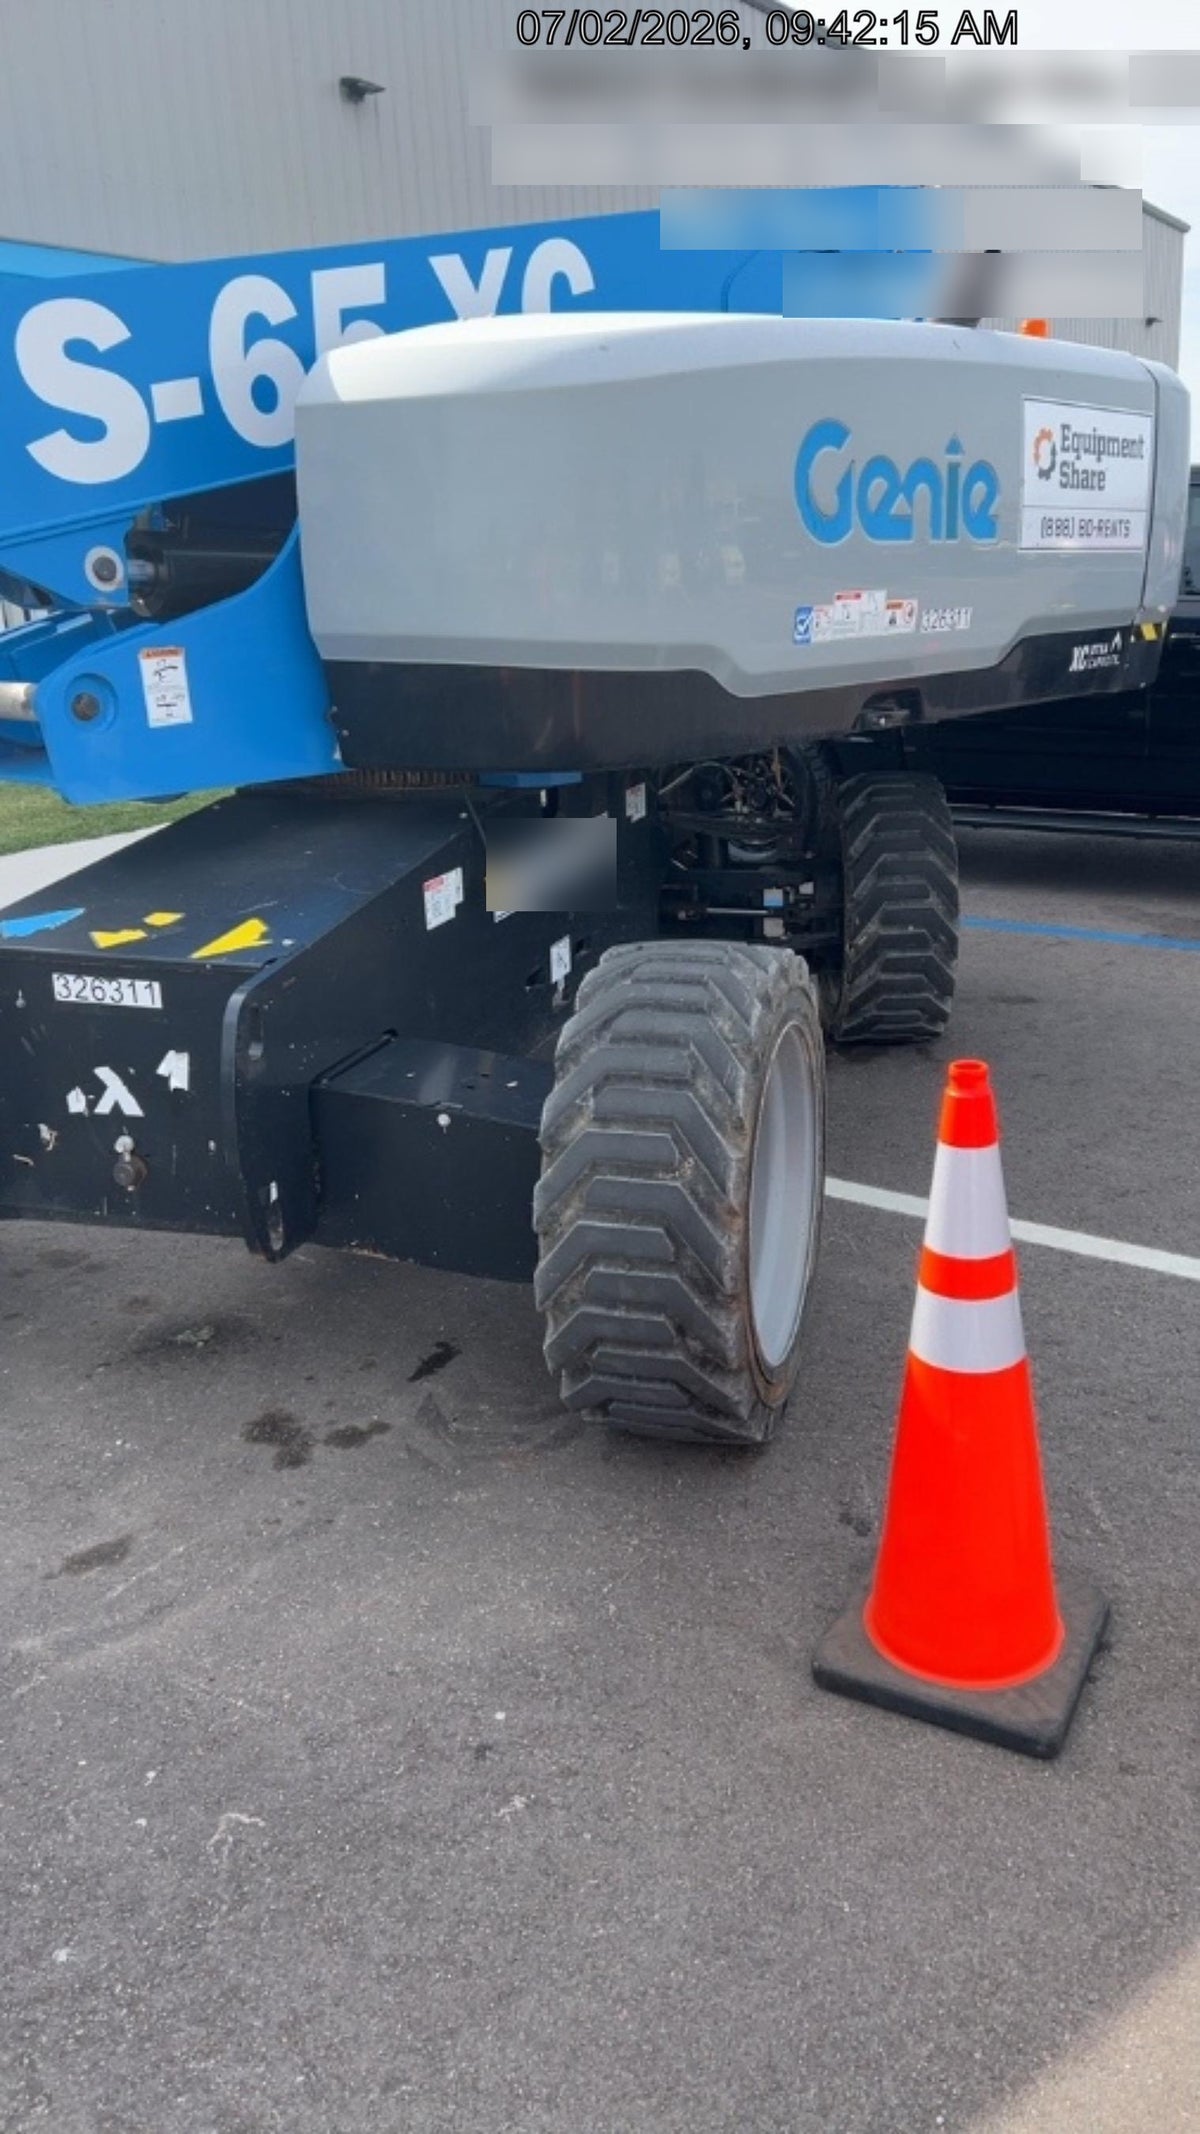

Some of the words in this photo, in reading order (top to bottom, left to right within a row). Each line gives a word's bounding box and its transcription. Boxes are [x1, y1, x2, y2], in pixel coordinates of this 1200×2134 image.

[1059, 423, 1145, 463] Equipment
[794, 417, 1001, 547] Genie
[1059, 460, 1107, 491] Share
[56, 974, 156, 1006] 326311
